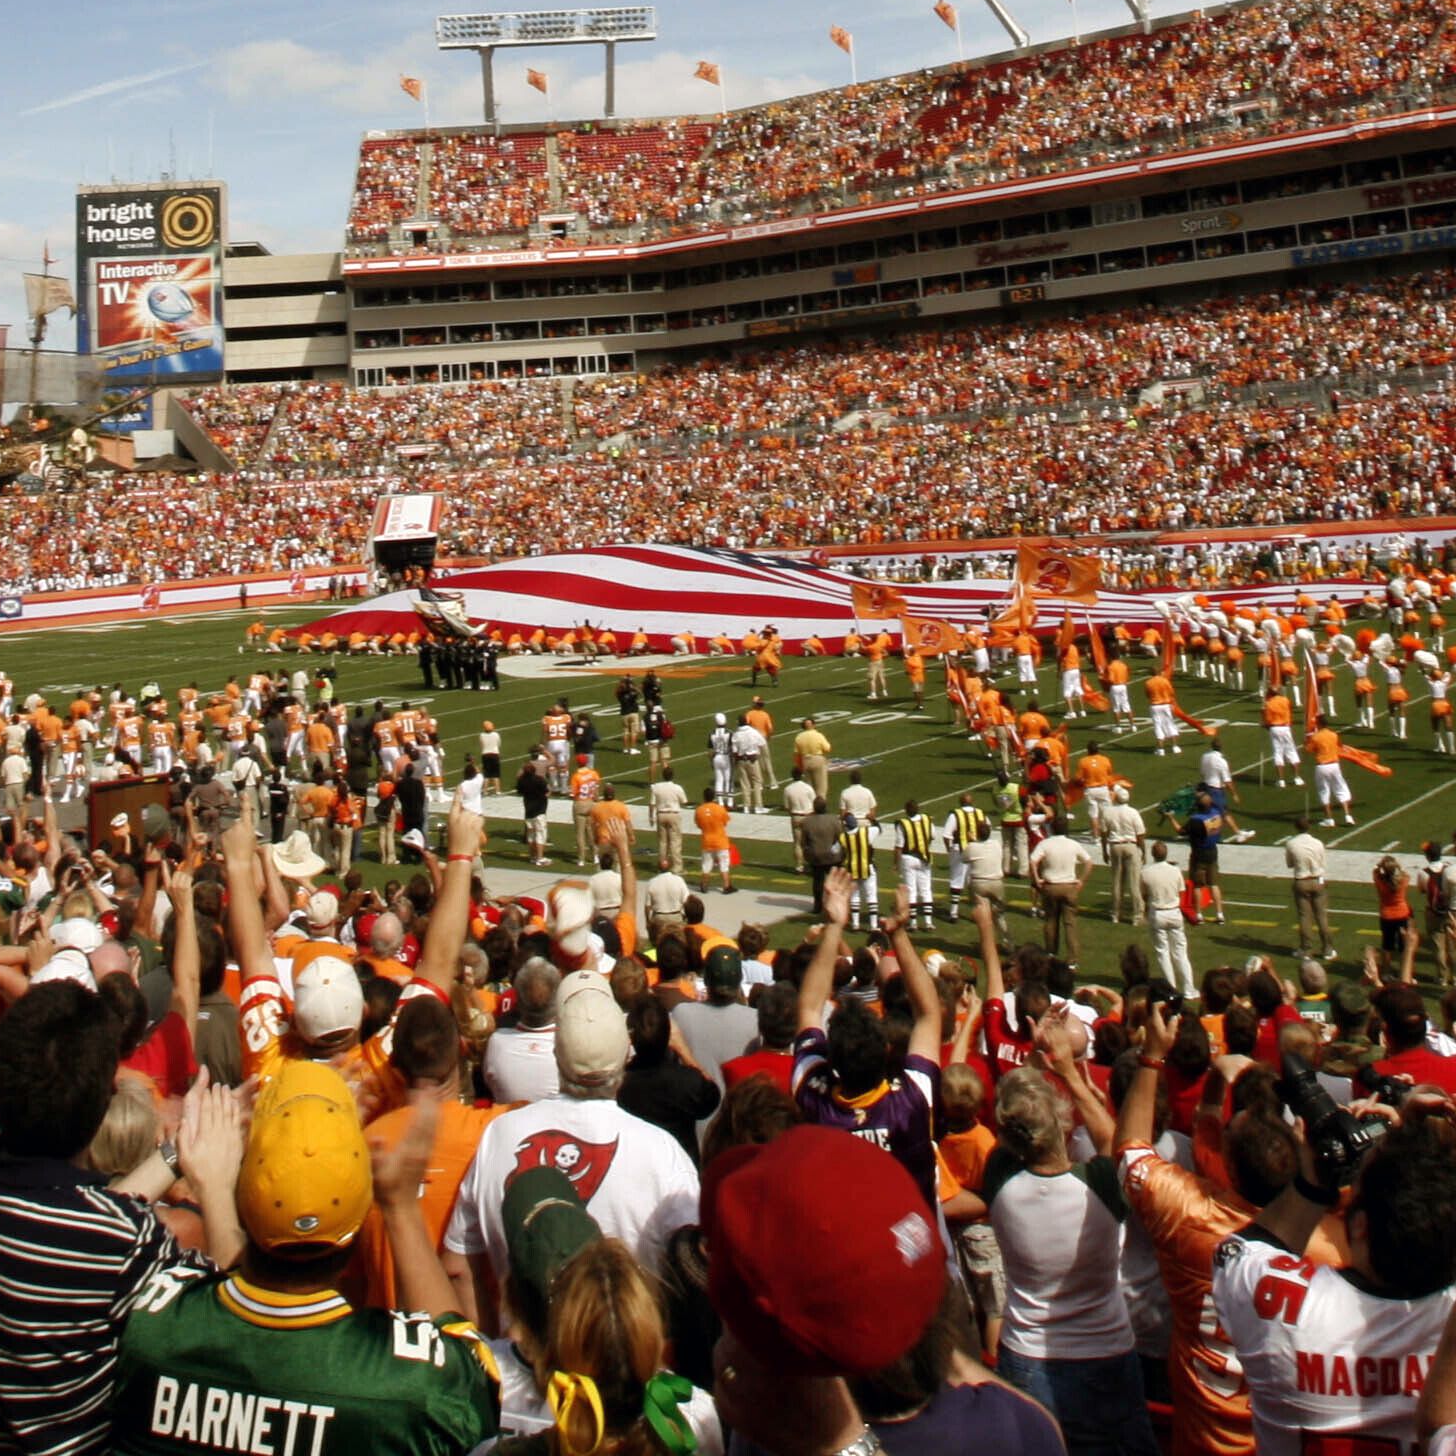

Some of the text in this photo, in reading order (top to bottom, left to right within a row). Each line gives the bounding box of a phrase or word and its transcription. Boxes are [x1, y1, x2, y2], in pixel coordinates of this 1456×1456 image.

[87, 201, 155, 224] bright
[87, 225, 156, 243] house
[1181, 213, 1224, 234] Sprint
[100, 262, 178, 280] Interactive
[99, 282, 130, 306] TV
[548, 722, 567, 737] 95
[151, 1375, 336, 1456] BARNETT
